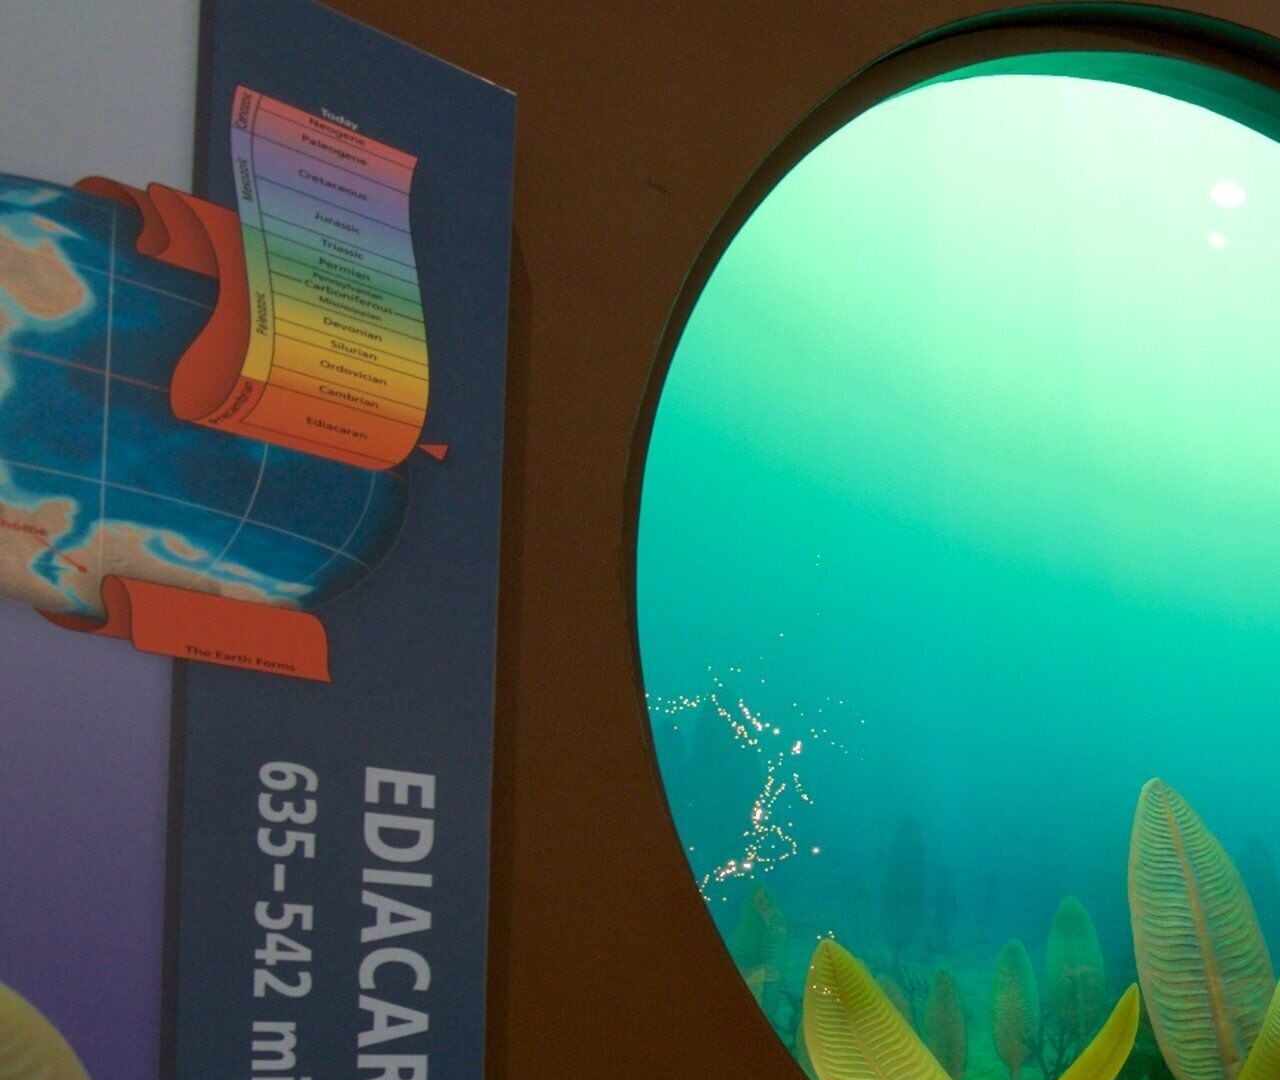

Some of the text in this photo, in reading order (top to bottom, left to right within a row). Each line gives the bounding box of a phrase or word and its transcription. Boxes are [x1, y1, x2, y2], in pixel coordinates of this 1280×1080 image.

[309, 117, 366, 146] Neogene
[321, 107, 359, 131] Today
[301, 134, 367, 166] Paleogene
[298, 169, 368, 202] Cretaceous
[314, 212, 361, 236] Jurassic
[321, 238, 364, 260] Triassic
[319, 257, 370, 282] Permian
[304, 279, 394, 316] Carboniferous
[323, 316, 383, 342] Devonian
[330, 340, 378, 361] Silurian
[319, 359, 388, 386] Ordovician
[319, 385, 380, 409] Cambrian
[305, 416, 368, 440] Ediacaran
[186, 645, 296, 672] The Earth Forms
